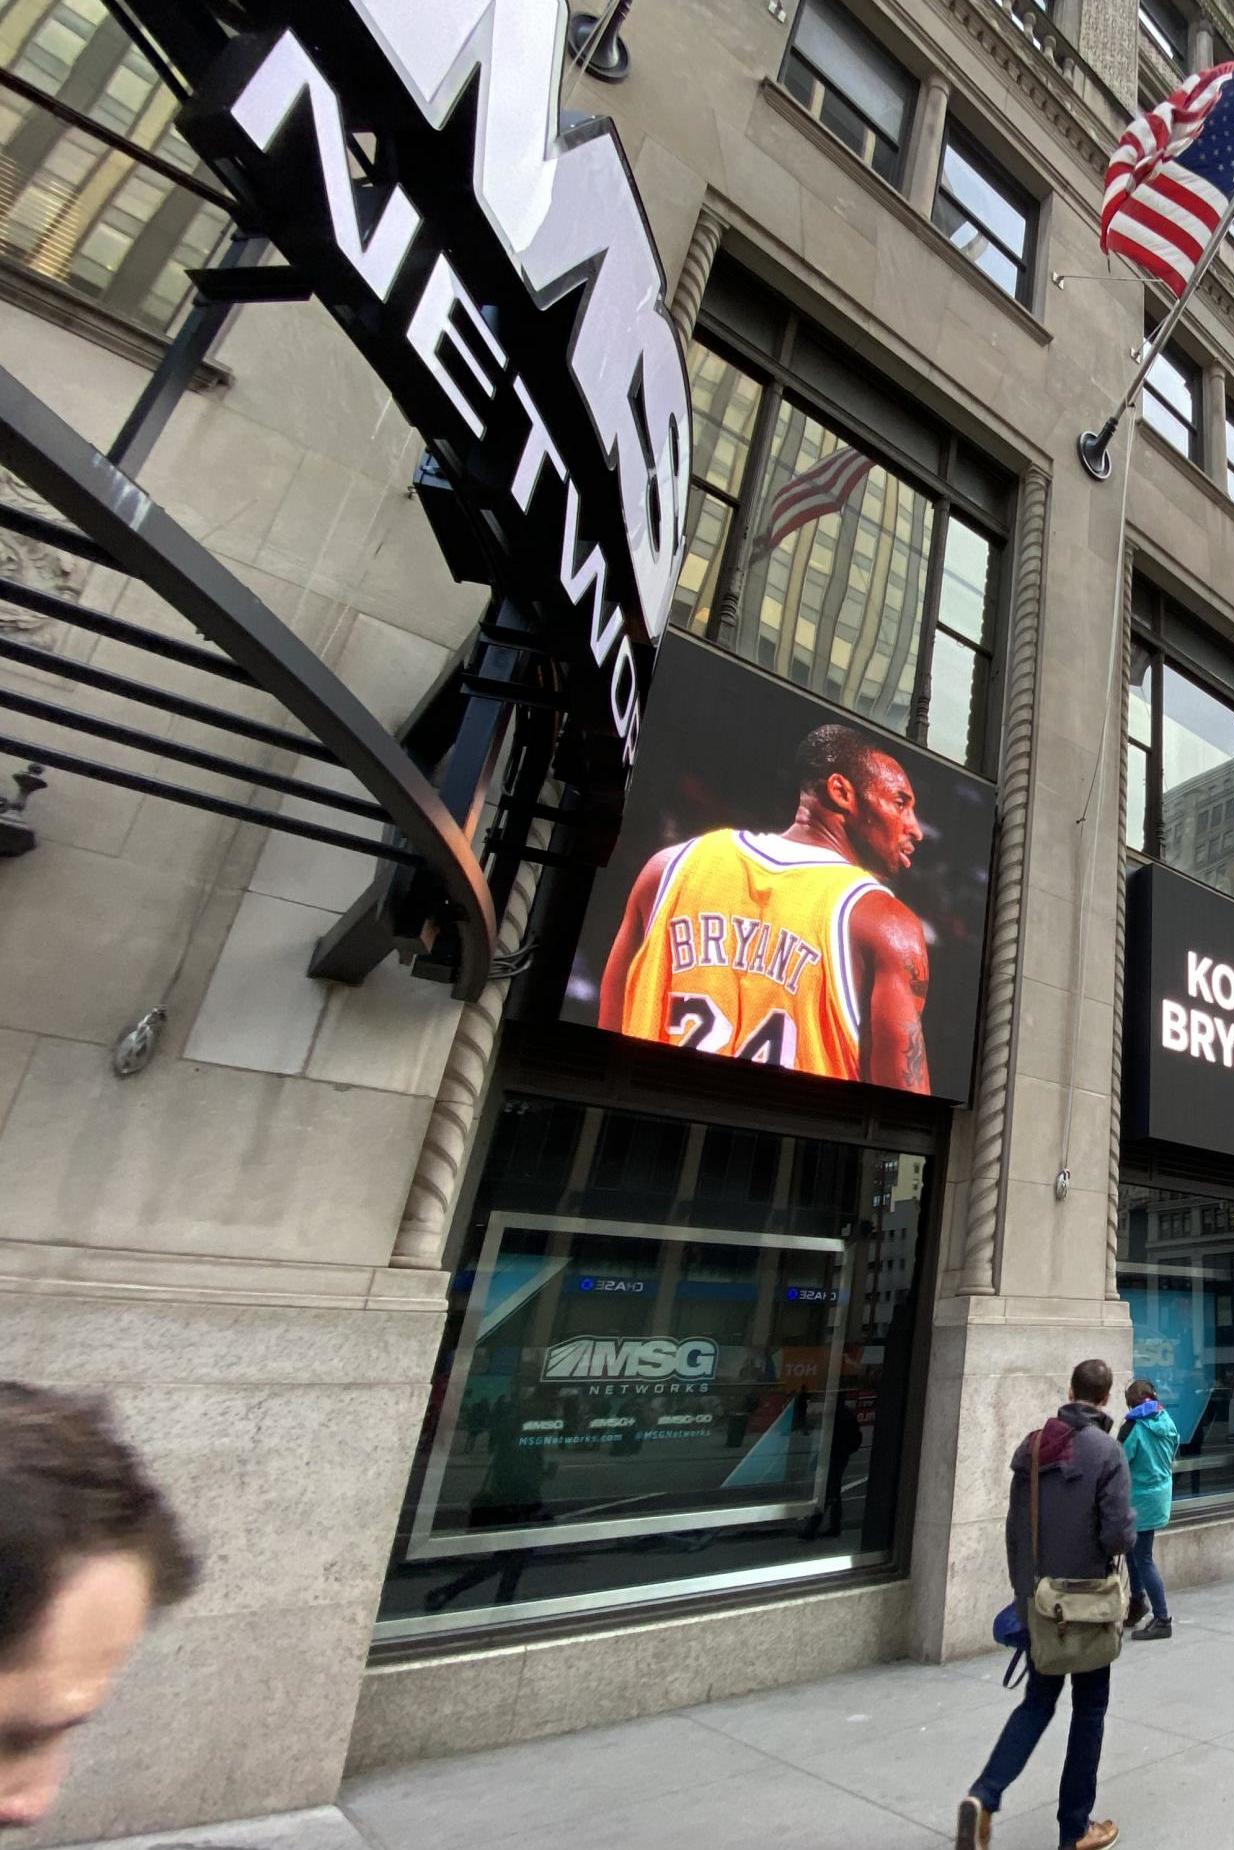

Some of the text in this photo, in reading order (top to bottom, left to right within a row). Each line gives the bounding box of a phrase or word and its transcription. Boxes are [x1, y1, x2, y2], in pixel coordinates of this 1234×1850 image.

[230, 29, 642, 792] NETWOR
[668, 913, 821, 995] BRYANT
[666, 991, 799, 1070] 24
[586, 1338, 718, 1379] MSG
[589, 1384, 709, 1395] NETWORKS
